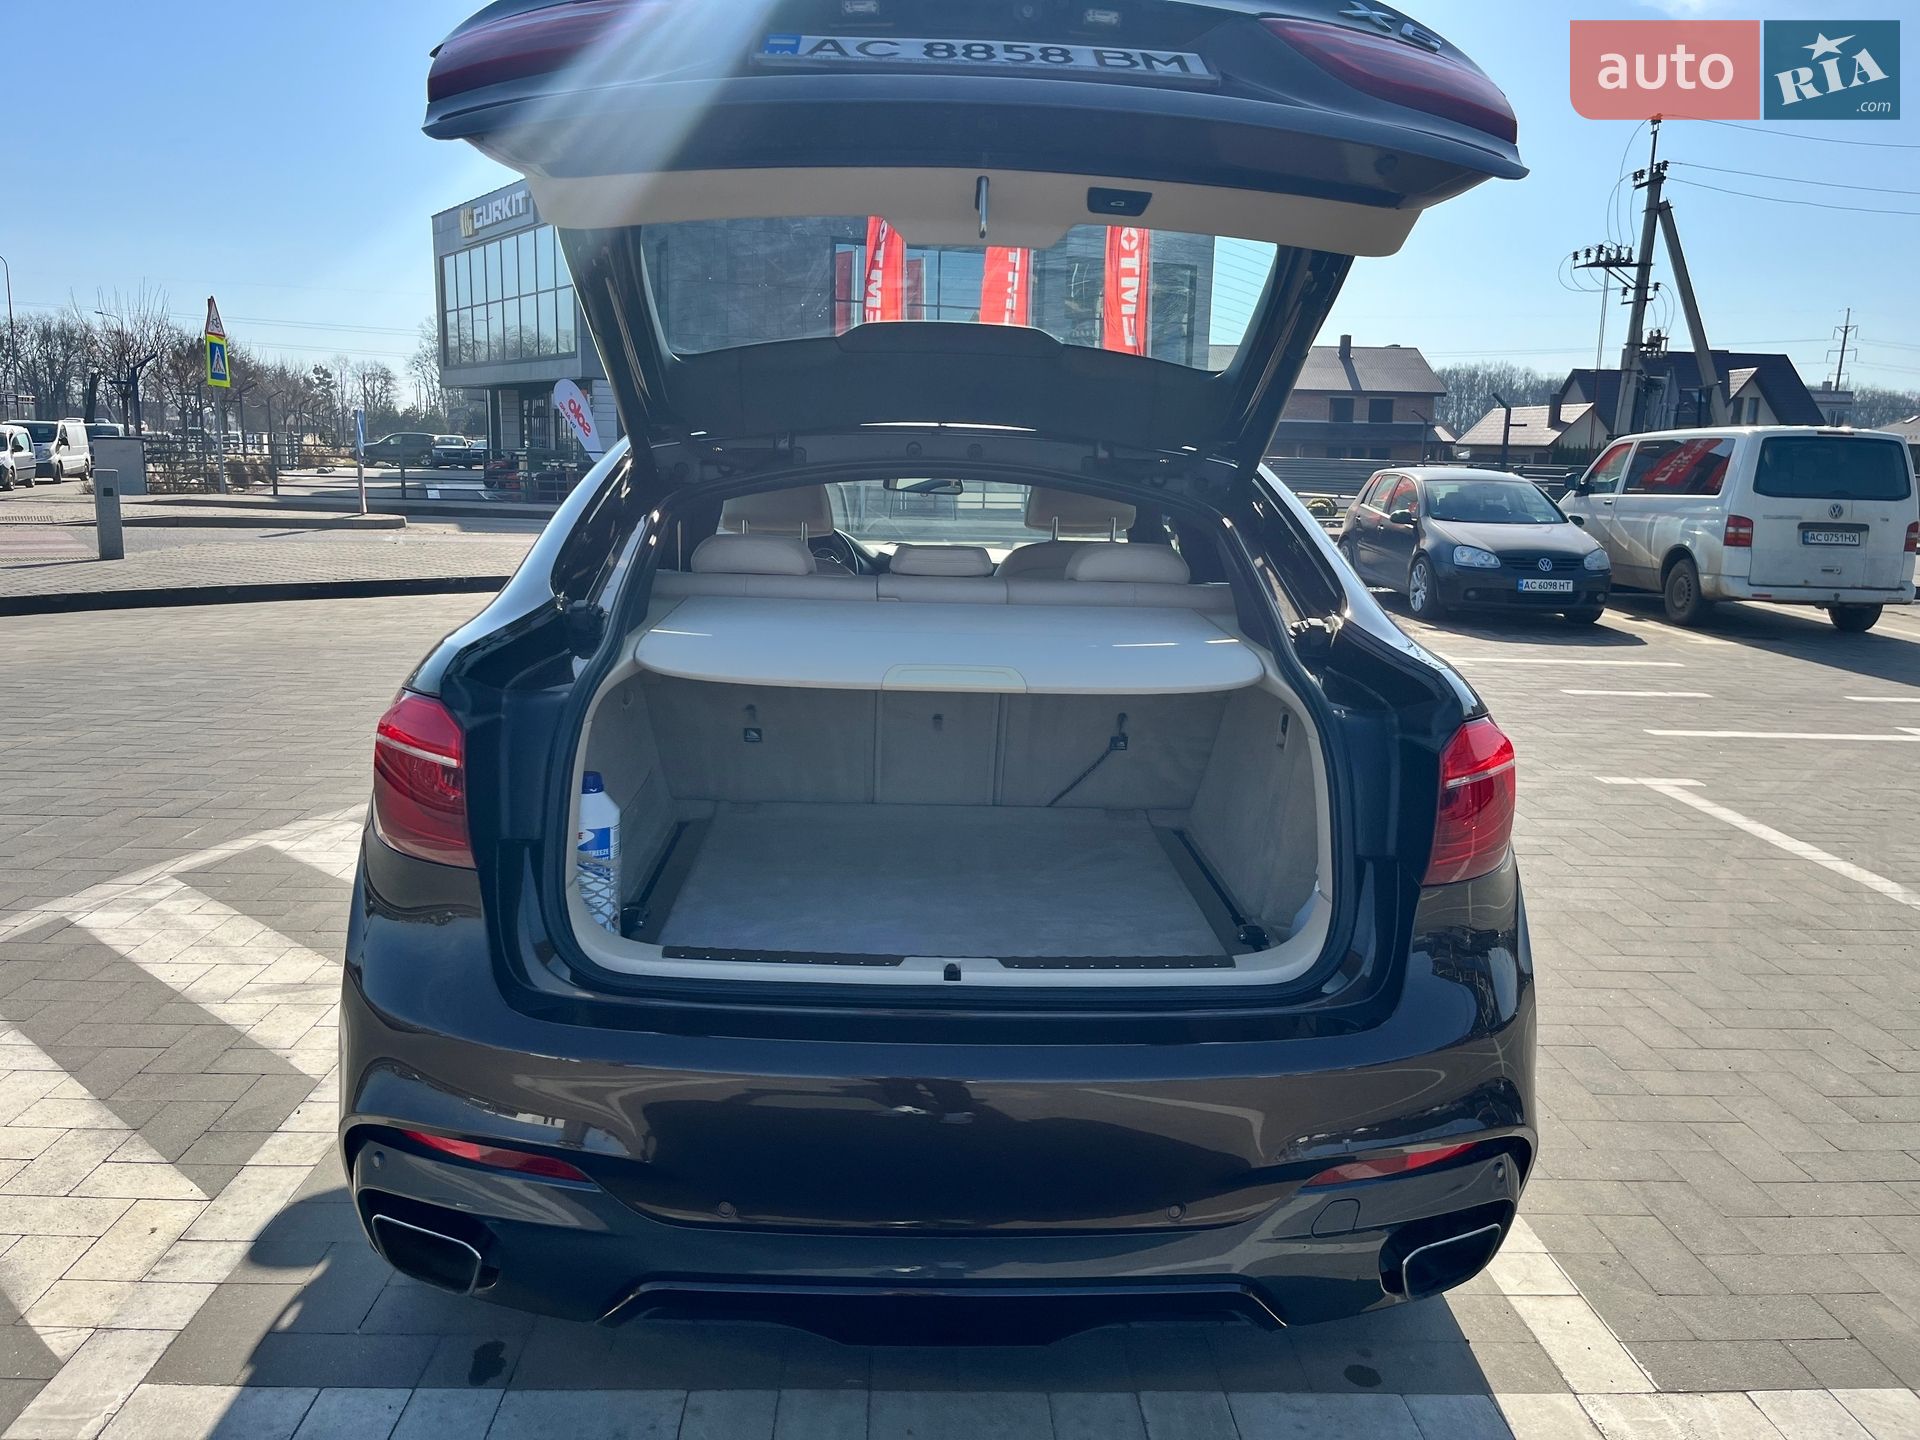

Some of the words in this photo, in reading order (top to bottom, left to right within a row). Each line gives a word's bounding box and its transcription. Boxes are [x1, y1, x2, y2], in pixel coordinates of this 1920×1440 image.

[804, 38, 901, 57] AC
[922, 41, 1074, 65] 8858
[1093, 49, 1191, 73] BM
[473, 190, 525, 229] GURKIT
[1809, 533, 1823, 542] AC
[1823, 533, 1844, 543] 0751
[1844, 534, 1857, 543] HX
[1523, 581, 1537, 590] AC
[1538, 581, 1558, 591] 6098
[1559, 581, 1571, 591] HT
